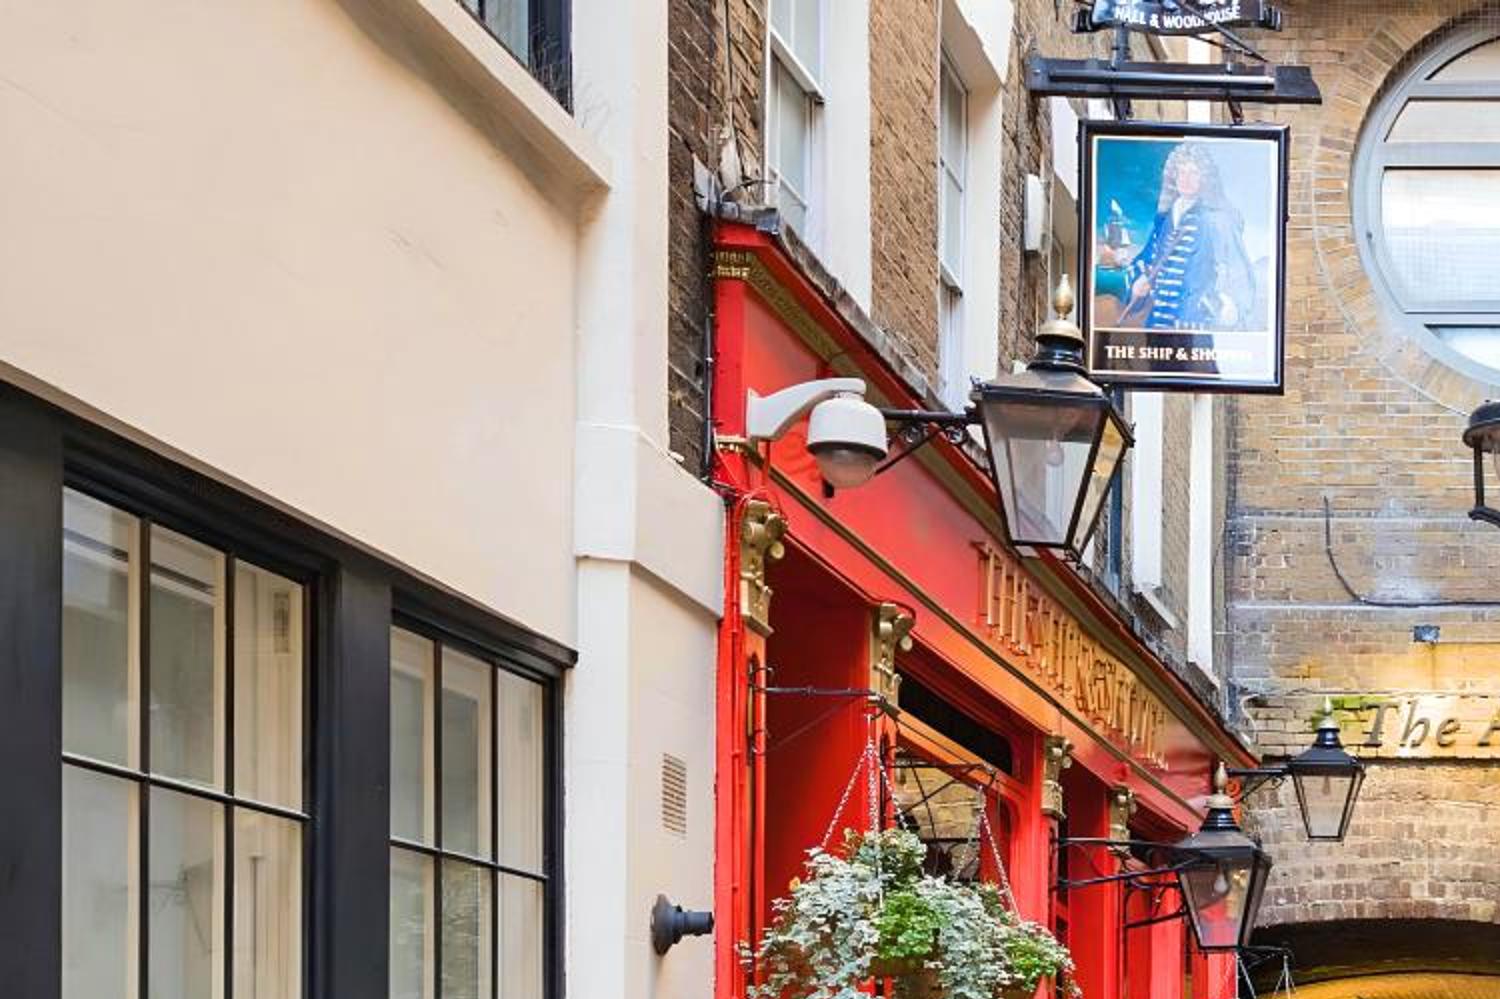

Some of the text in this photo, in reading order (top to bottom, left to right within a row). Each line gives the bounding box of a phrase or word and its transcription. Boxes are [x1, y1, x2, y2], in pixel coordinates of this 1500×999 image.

[1114, 5, 1147, 25] HALL
[1149, 13, 1160, 29] &
[1104, 345, 1136, 360] THE
[1139, 347, 1173, 361] SHIP
[1175, 347, 1189, 361] &
[1362, 701, 1460, 748] The
